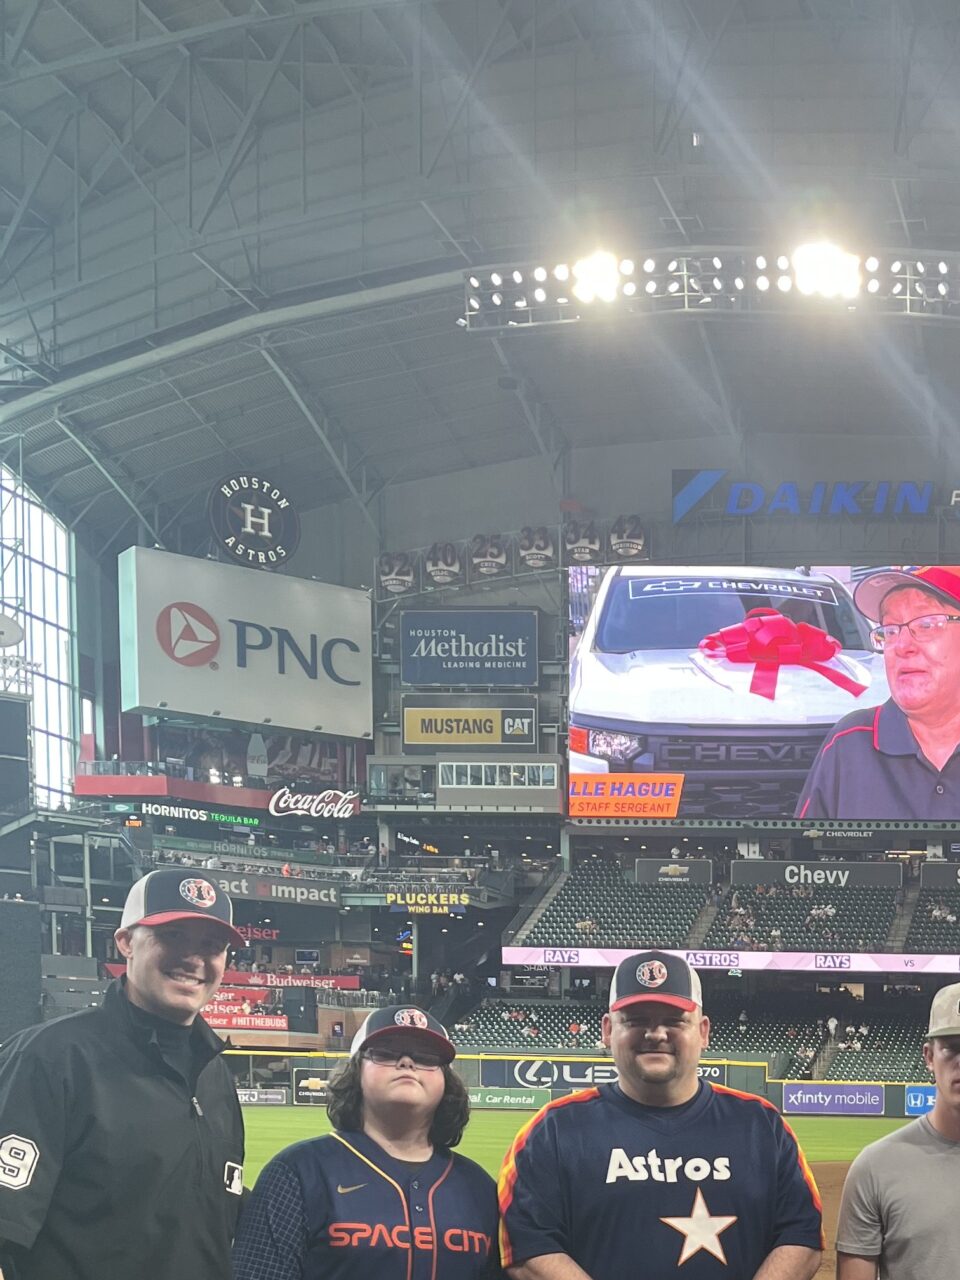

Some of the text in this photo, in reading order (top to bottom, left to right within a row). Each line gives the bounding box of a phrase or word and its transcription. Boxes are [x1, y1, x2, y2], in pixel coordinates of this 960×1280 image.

[220, 476, 290, 509] HOUSTON
[725, 480, 934, 516] DAIKIN
[241, 502, 272, 537] H
[472, 534, 503, 559] 25
[519, 526, 549, 551] 33
[224, 536, 287, 563] ASTROS
[708, 581, 824, 597] CHEVROLET
[409, 629, 456, 637] HOUSTON
[228, 619, 361, 686] PNC
[410, 634, 527, 658] Methodist
[420, 718, 532, 735] MUSTANG CAT
[609, 782, 676, 798] HAGUE
[268, 786, 359, 820] Coca-Cola
[577, 802, 611, 813] STAFF
[613, 803, 671, 814] SERGEANT
[141, 803, 260, 826] HORNITOS TEQUILA BAR
[213, 840, 268, 857] HORNITOS
[784, 865, 850, 887] Chevy
[271, 884, 337, 903] impact
[386, 893, 470, 905] PLUCKERS
[407, 905, 449, 914] WING BAR
[235, 923, 280, 941] eiser
[544, 950, 739, 966] RAYS ASTROS
[816, 955, 850, 969] RAYS
[903, 958, 915, 968] VS
[266, 974, 336, 988] Budweiser
[231, 1017, 287, 1028] #HITTHEBUDS
[696, 1067, 720, 1078] 370
[485, 1094, 502, 1104] Car
[503, 1094, 535, 1105] Rental
[788, 1091, 880, 1107] xfinity mobile
[606, 1148, 732, 1184] Astros
[328, 1223, 491, 1256] SPACE CITY
